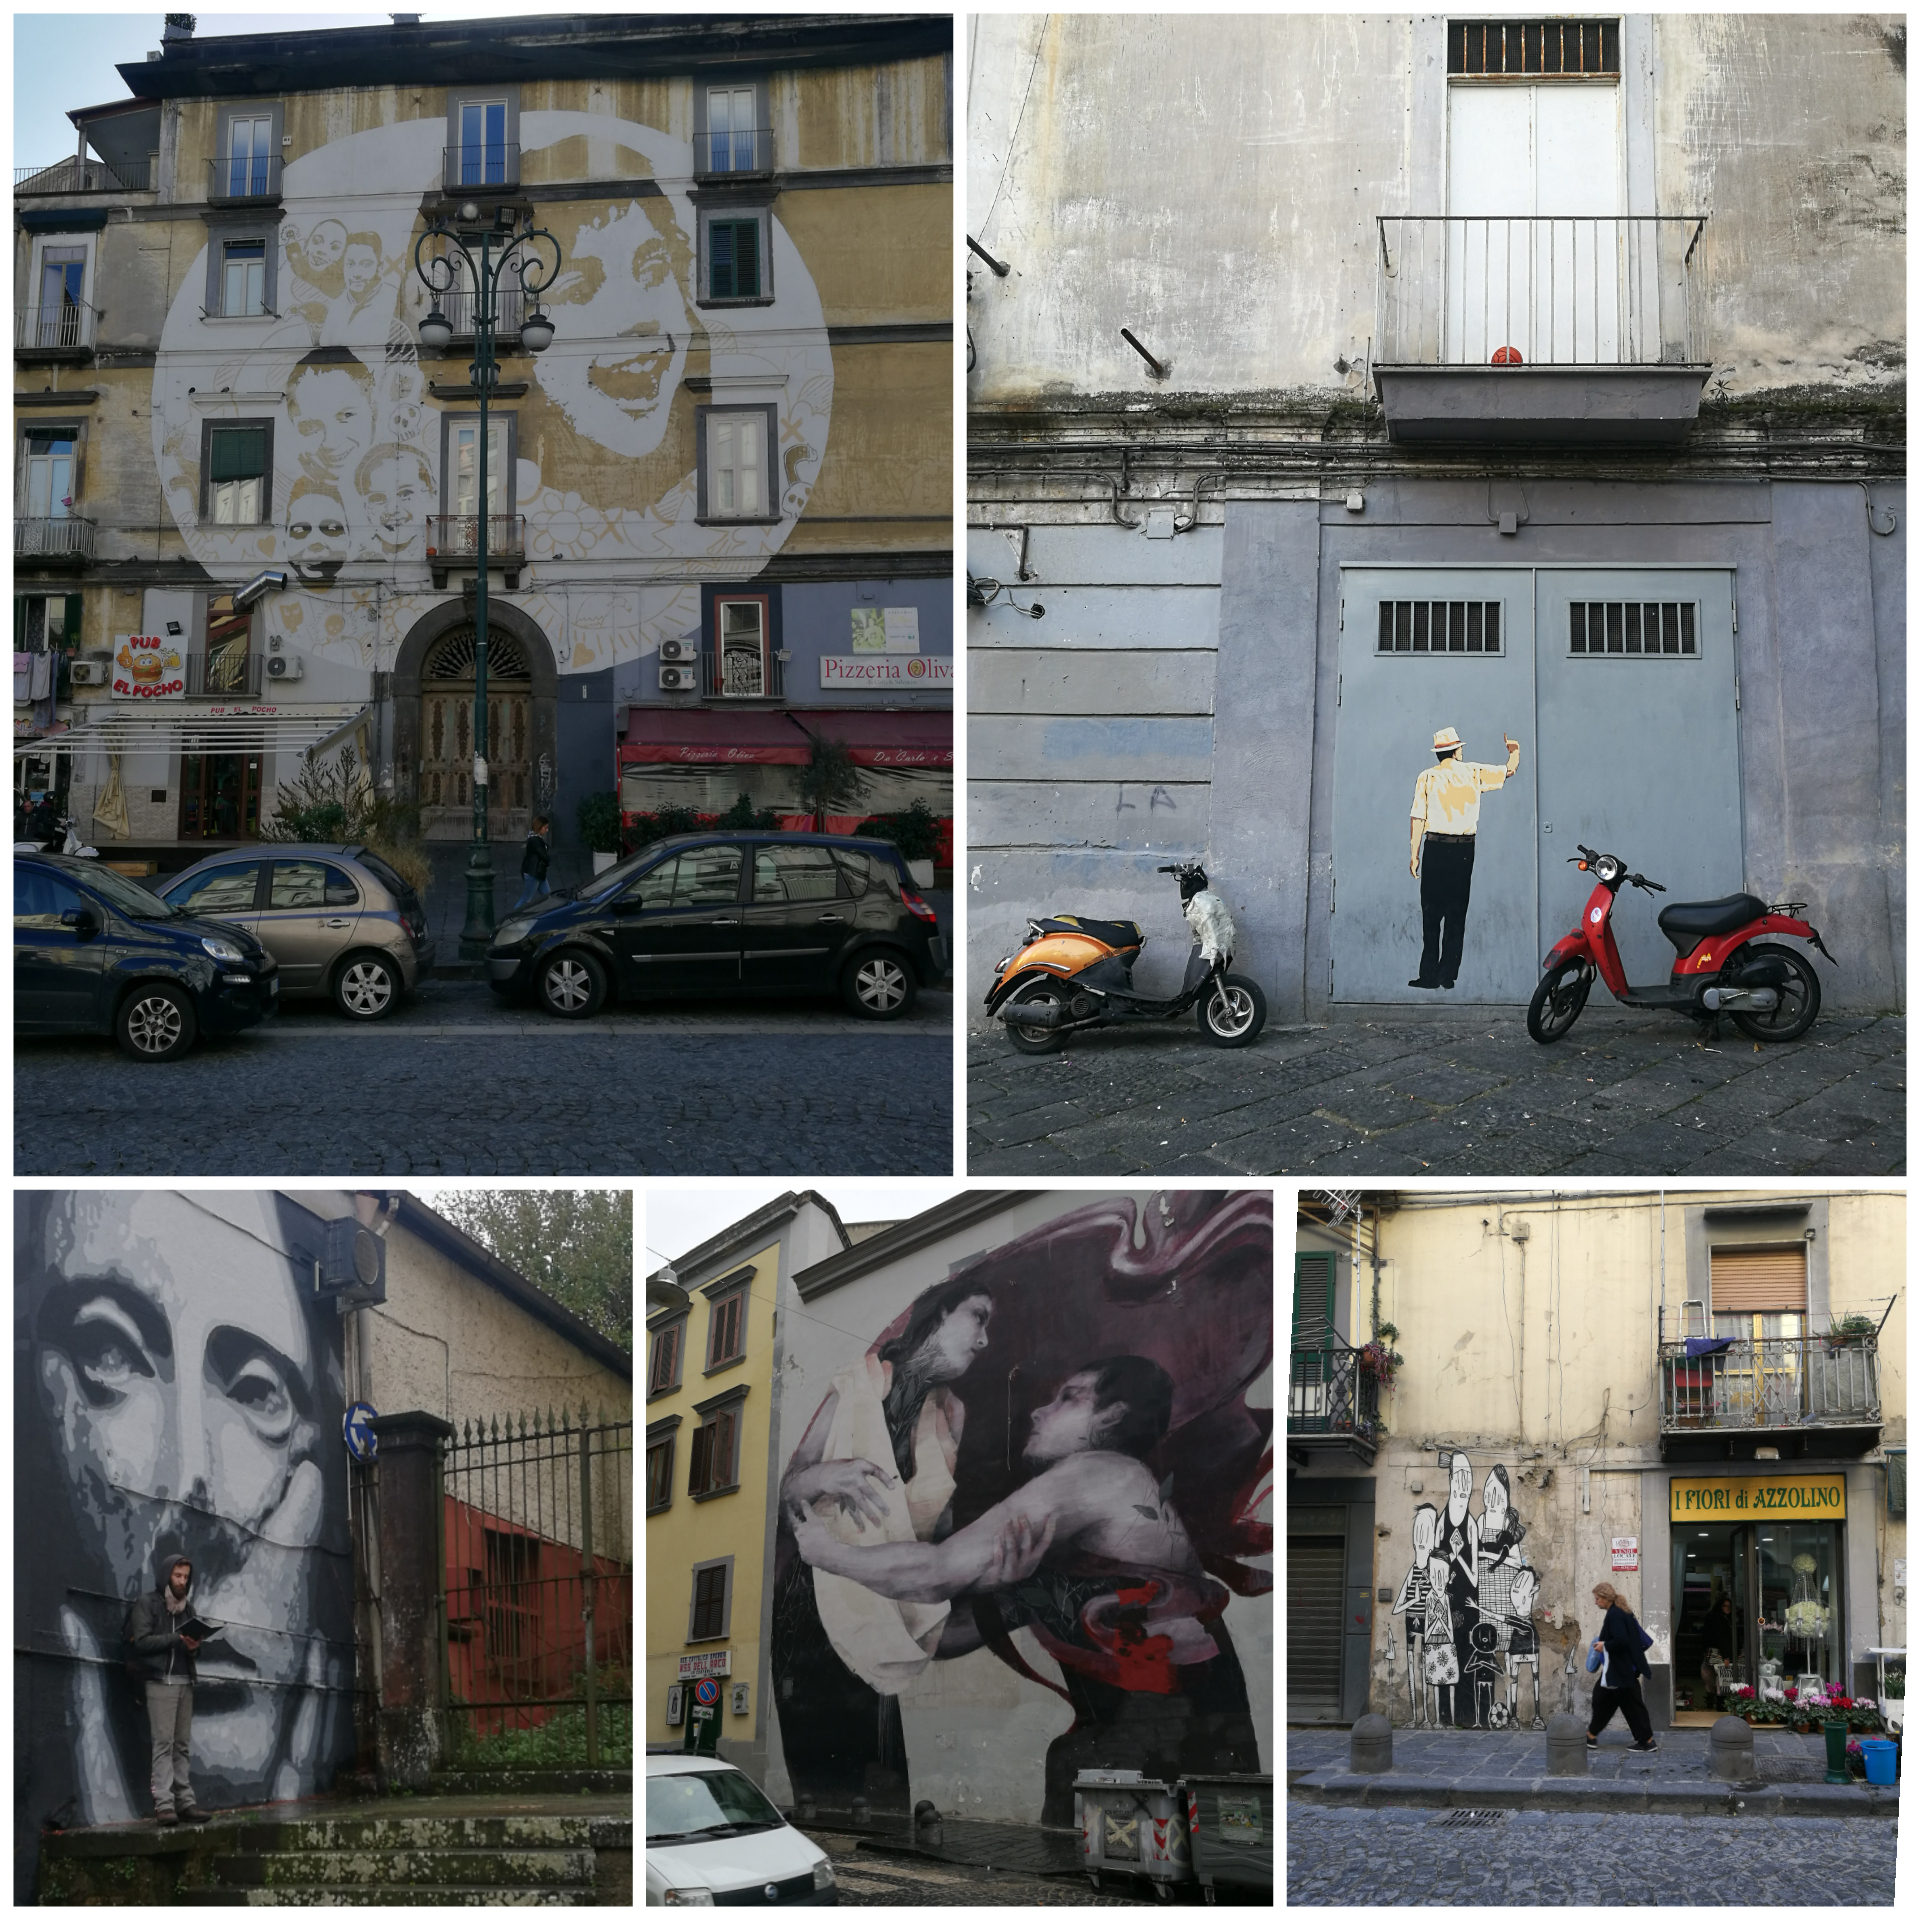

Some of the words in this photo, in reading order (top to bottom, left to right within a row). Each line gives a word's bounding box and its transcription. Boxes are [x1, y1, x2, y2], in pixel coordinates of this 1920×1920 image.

[130, 636, 162, 650] PUB
[825, 658, 901, 679] Pizzeria
[907, 658, 954, 679] Oliv
[113, 678, 131, 694] EL
[132, 680, 184, 698] POCHO
[679, 746, 718, 762] Pizzeria
[873, 751, 891, 762] Da
[896, 750, 926, 762] Carla
[1675, 1490, 1681, 1510] I
[1685, 1488, 1731, 1510] FIORI
[1735, 1488, 1749, 1509] di
[1753, 1486, 1841, 1509] AZZOLINO
